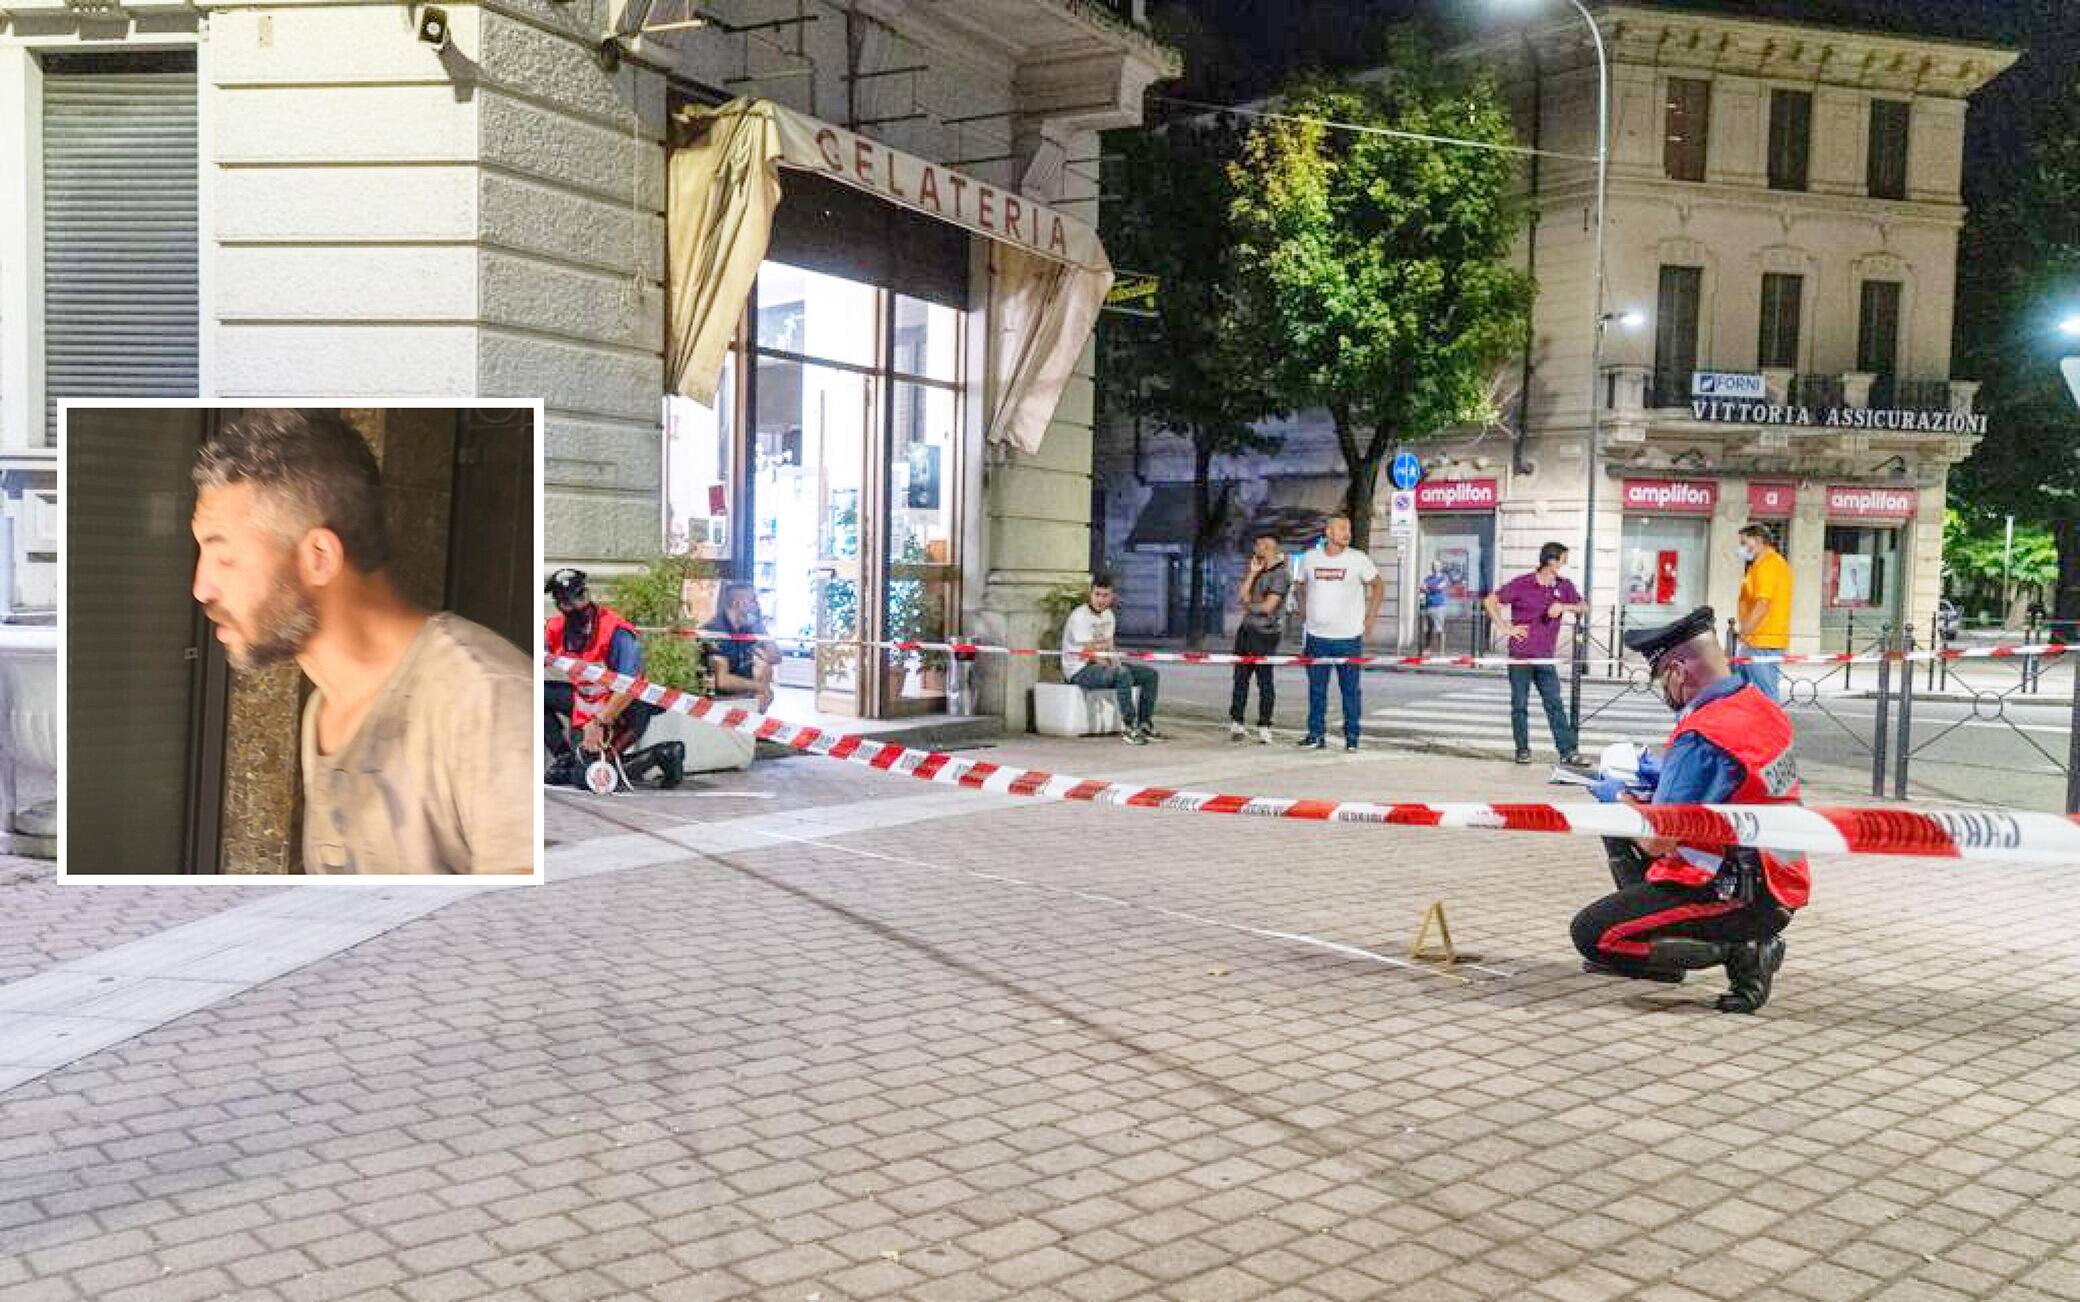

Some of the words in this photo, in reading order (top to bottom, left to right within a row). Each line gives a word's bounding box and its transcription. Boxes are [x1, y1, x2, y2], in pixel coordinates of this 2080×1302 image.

[815, 127, 1068, 254] GELATERIA
[1716, 374, 1761, 391] FORNI
[1692, 400, 1810, 426] VITTORIA
[1825, 407, 1988, 434] ASSICURAZIONI
[1421, 482, 1492, 507] amplifon
[1628, 482, 1710, 507] amplifon
[1831, 490, 1908, 515] amplifon
